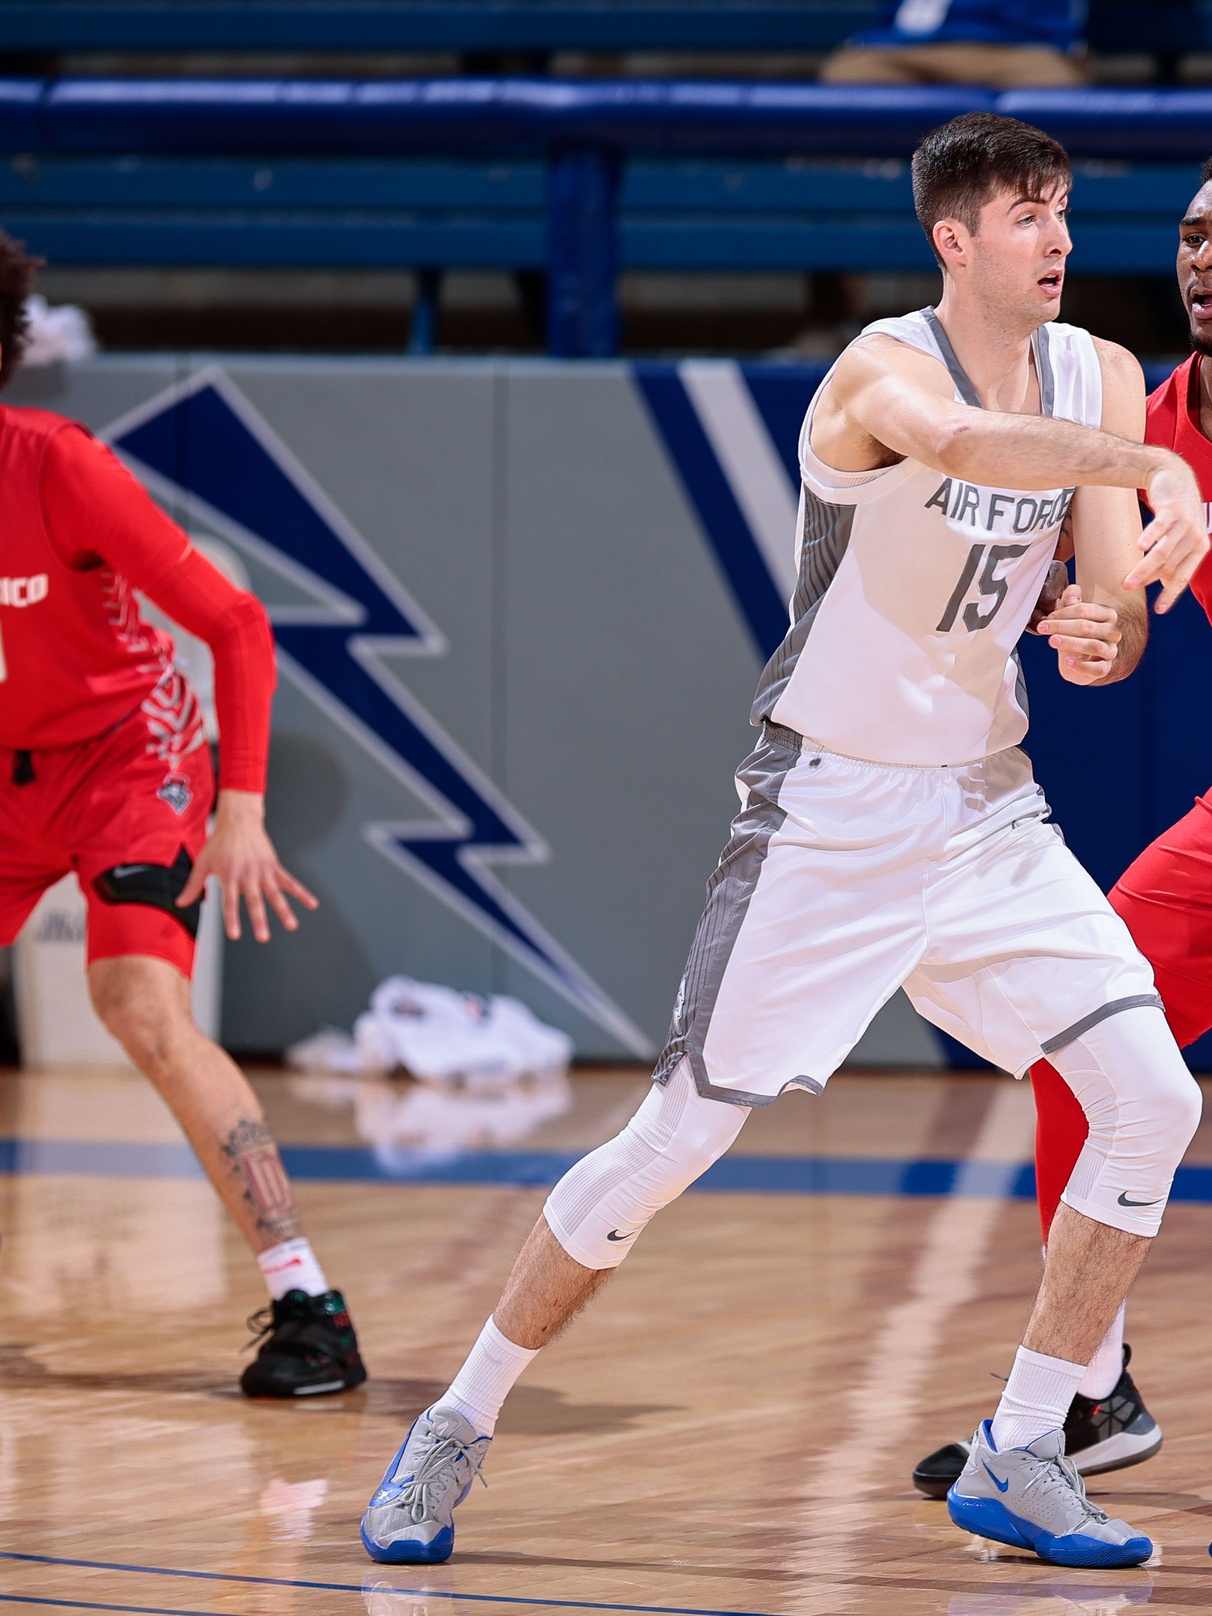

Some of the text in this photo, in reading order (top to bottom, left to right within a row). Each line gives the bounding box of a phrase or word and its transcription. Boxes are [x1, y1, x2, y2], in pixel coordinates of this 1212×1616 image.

[924, 477, 1077, 534] AIR FORCE
[0, 572, 50, 608] ICO
[935, 543, 1035, 633] 15
